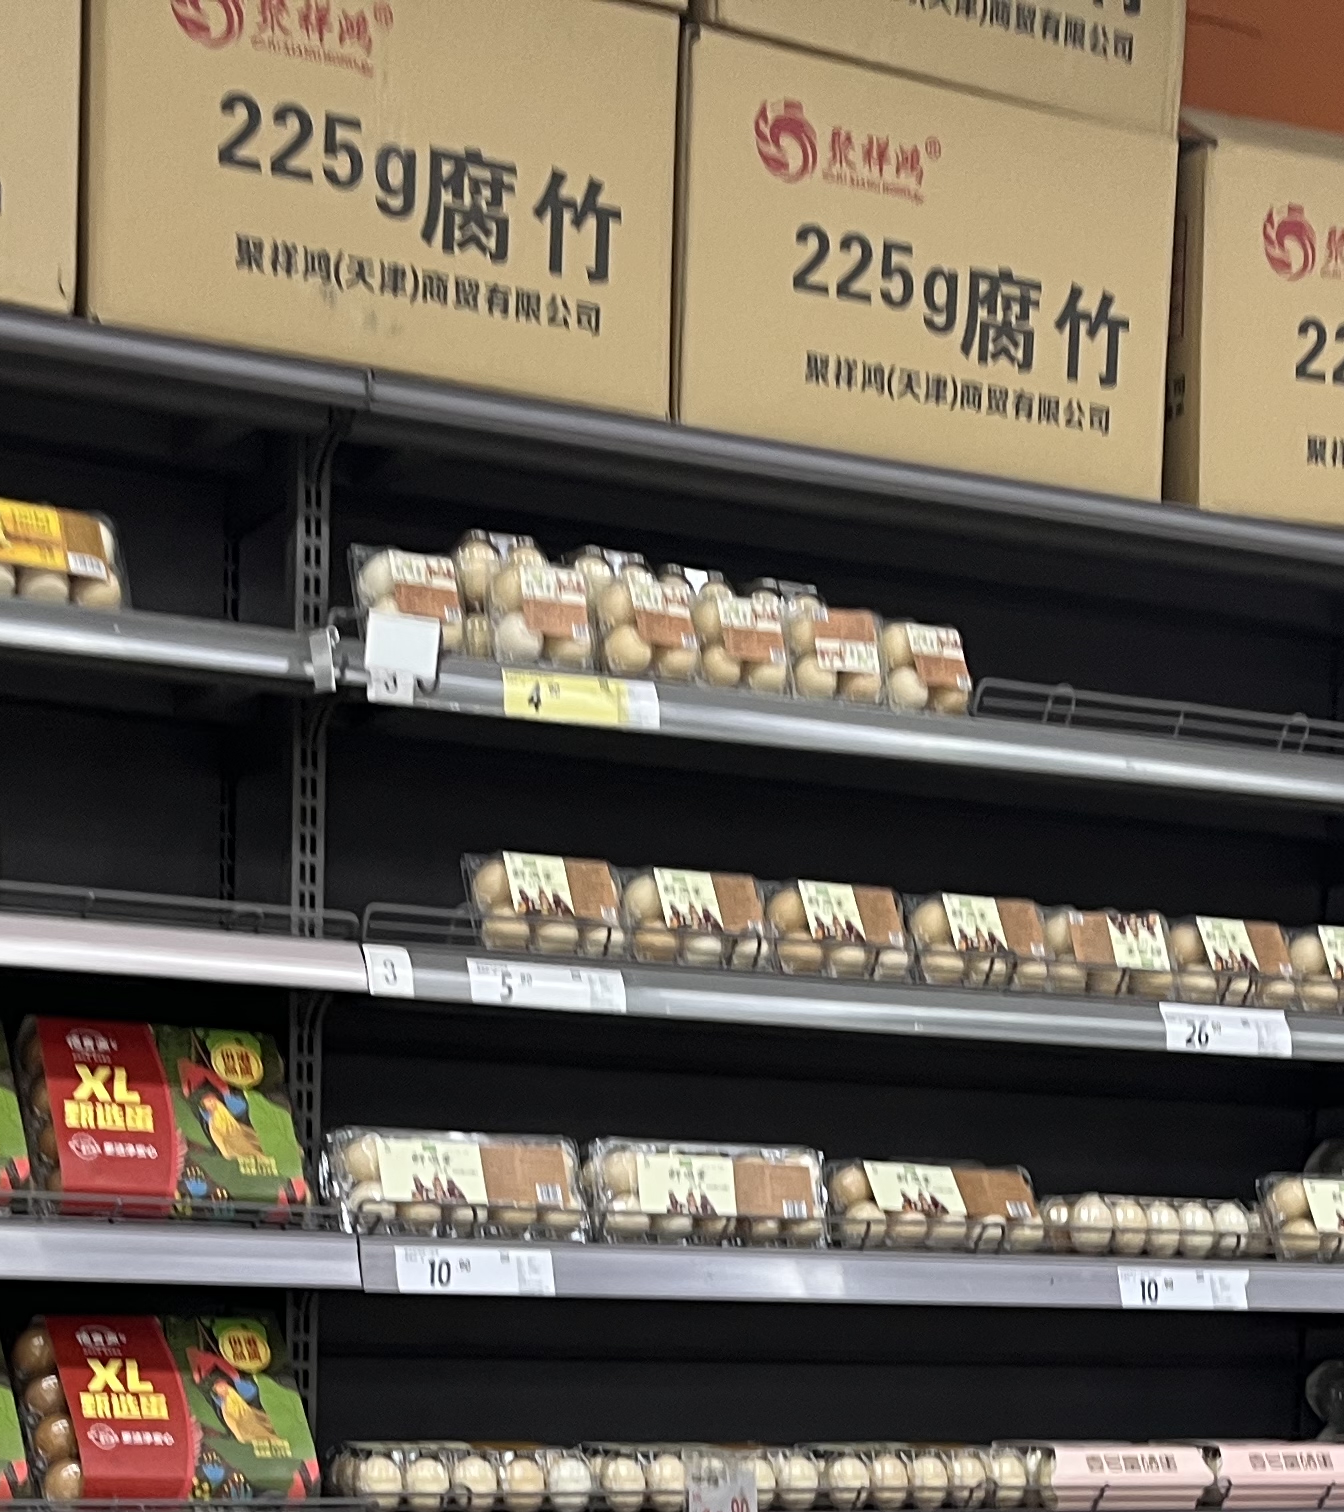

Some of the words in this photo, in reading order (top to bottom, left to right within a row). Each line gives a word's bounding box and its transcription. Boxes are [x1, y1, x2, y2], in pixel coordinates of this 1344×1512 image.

[218, 90, 622, 284] 225g腐竹
[793, 222, 1130, 388] 225g腐竹
[73, 1065, 141, 1104] XL
[87, 1358, 154, 1392] XL
